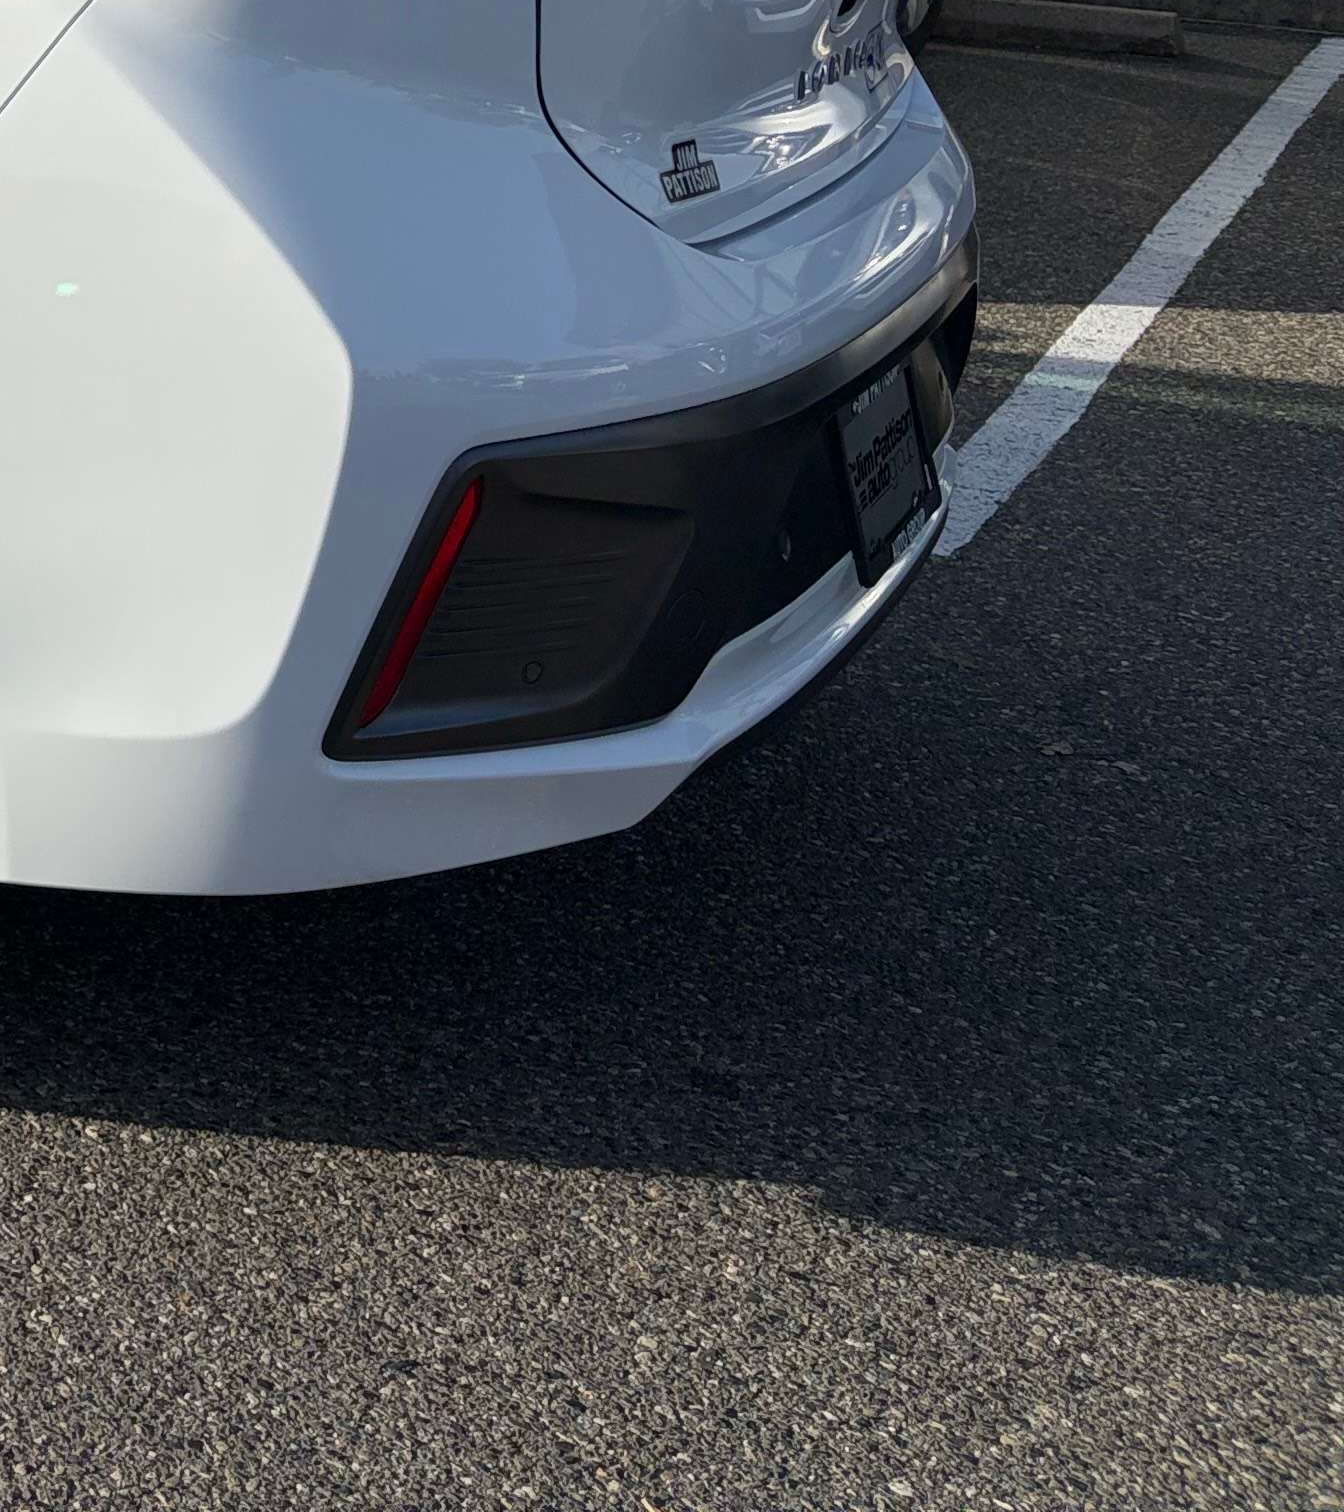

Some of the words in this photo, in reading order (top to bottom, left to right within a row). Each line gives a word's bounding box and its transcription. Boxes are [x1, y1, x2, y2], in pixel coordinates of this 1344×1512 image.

[676, 144, 698, 171] JIM
[662, 164, 718, 200] PATTISON
[853, 451, 874, 487] Jim
[872, 409, 913, 467] Pattison
